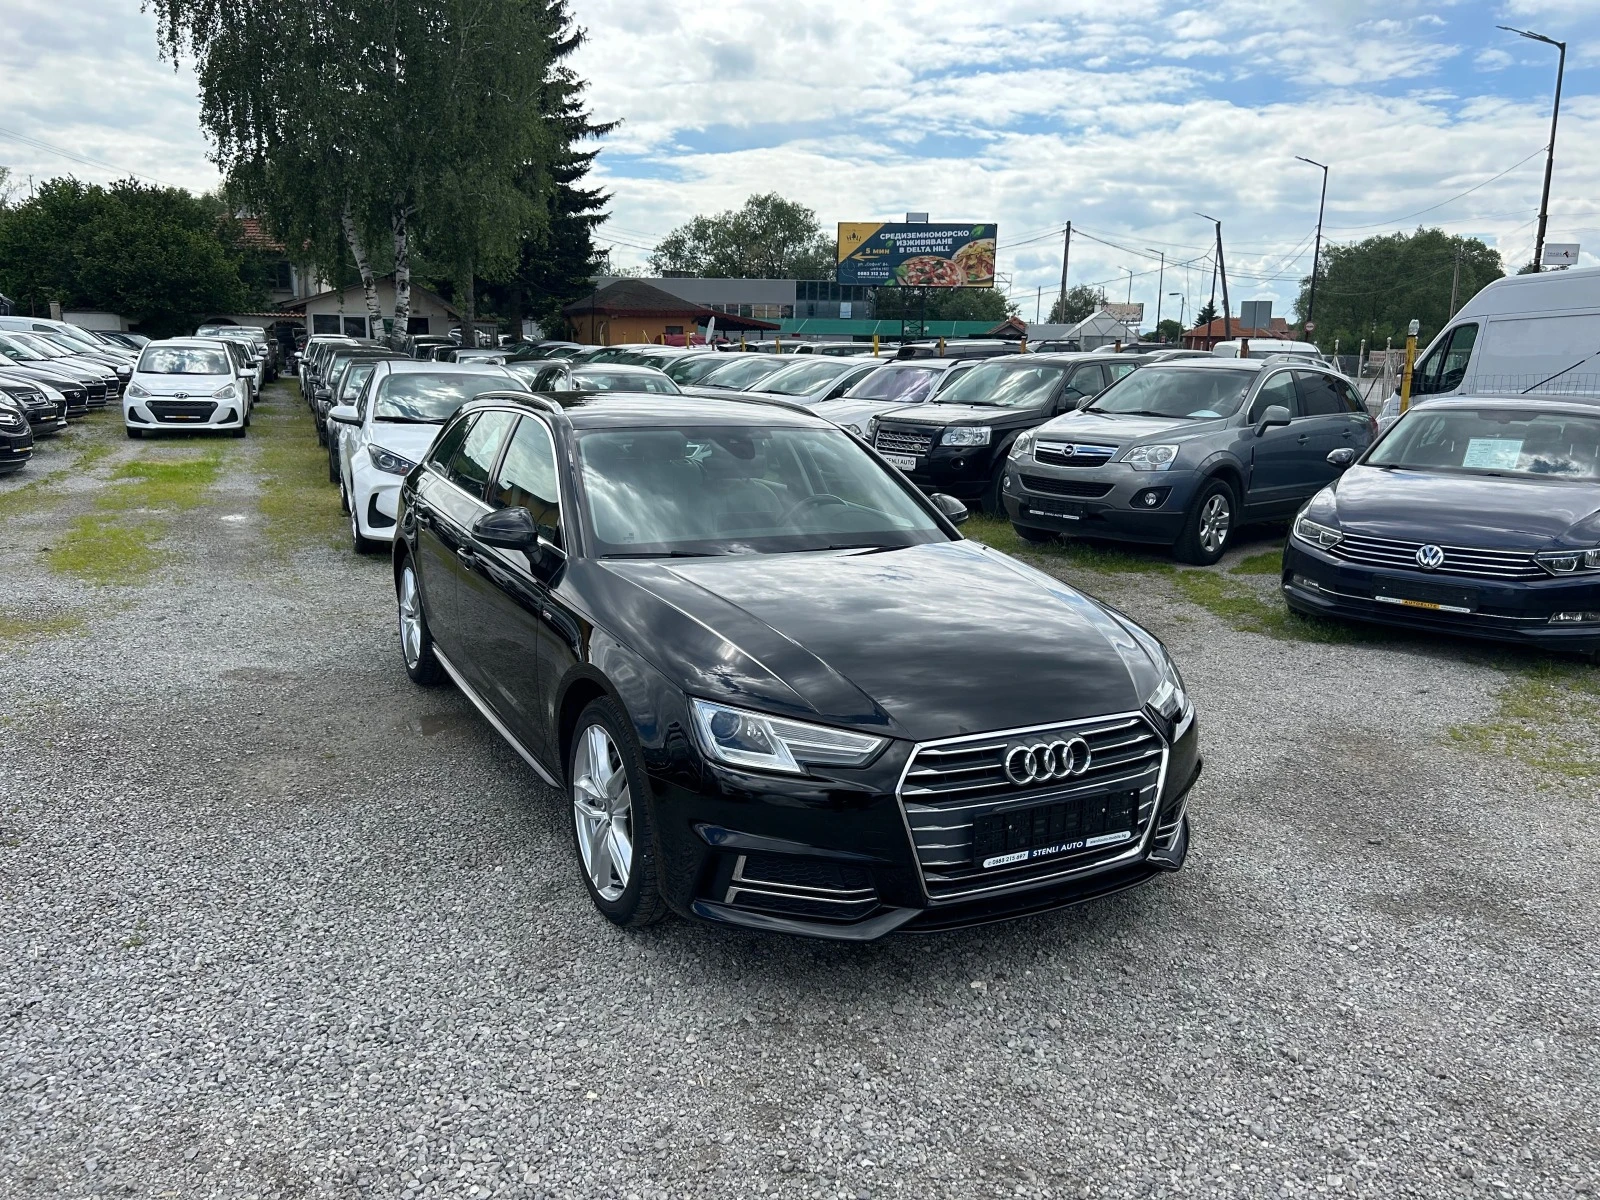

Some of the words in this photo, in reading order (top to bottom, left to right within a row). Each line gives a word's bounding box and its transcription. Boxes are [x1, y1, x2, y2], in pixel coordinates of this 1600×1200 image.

[880, 230, 970, 240] СРЕДИЗЕМНОМОРСКО
[896, 238, 953, 247] ИЗЖИВЯВАНЕ
[1032, 845, 1059, 857] STENLI
[1060, 841, 1084, 852] AUTO
